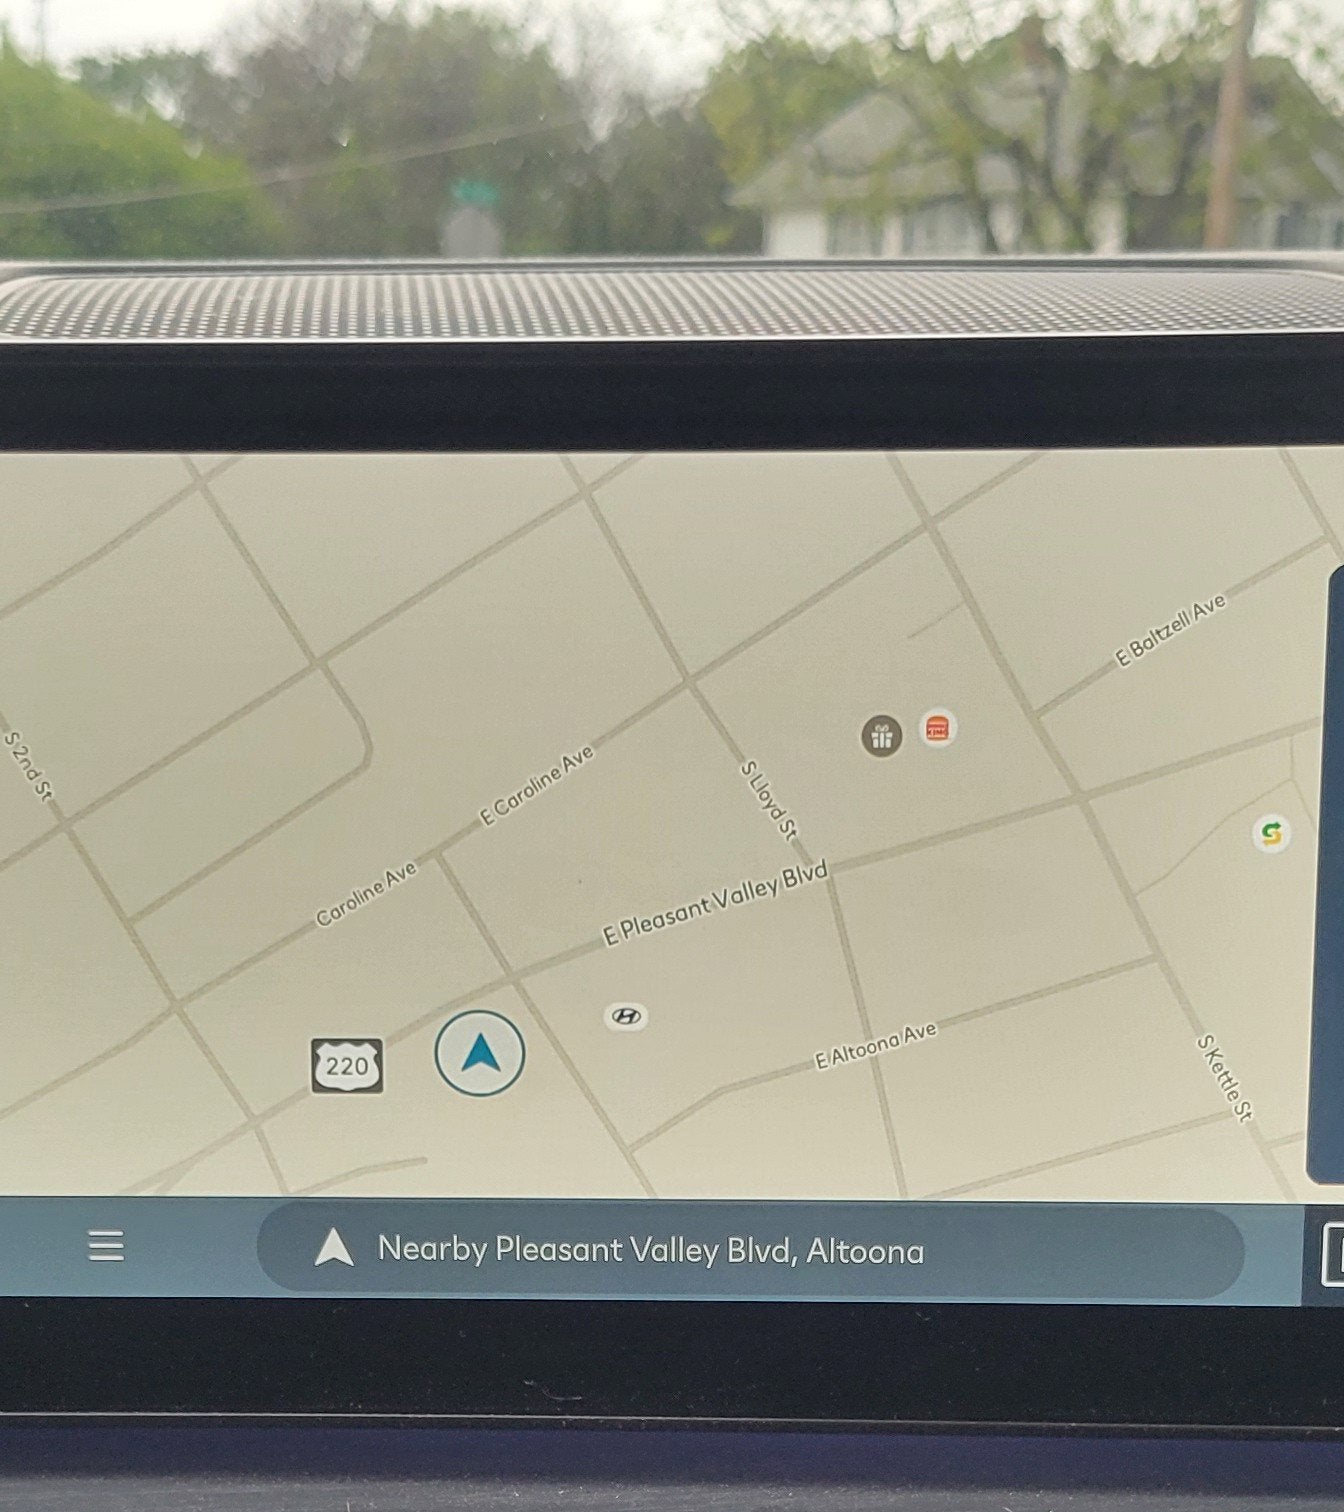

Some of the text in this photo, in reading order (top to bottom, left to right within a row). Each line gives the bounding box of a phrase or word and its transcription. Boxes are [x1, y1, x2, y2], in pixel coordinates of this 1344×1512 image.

[1115, 595, 1226, 667] E Baltzell Ave
[4, 731, 53, 803] S 2nd St
[479, 746, 594, 827] E Caroline Ave
[741, 760, 797, 842] S Lloyd St
[316, 862, 417, 927] Caroline Ave
[602, 858, 829, 947] E Pleasant Valley Blvd
[326, 1056, 370, 1077] 220
[815, 1023, 937, 1070] E Altoona Ave
[1197, 1034, 1253, 1123] S Kettle St
[378, 1233, 925, 1269] Nearby Pleasant Valley Blvd, Altoona
